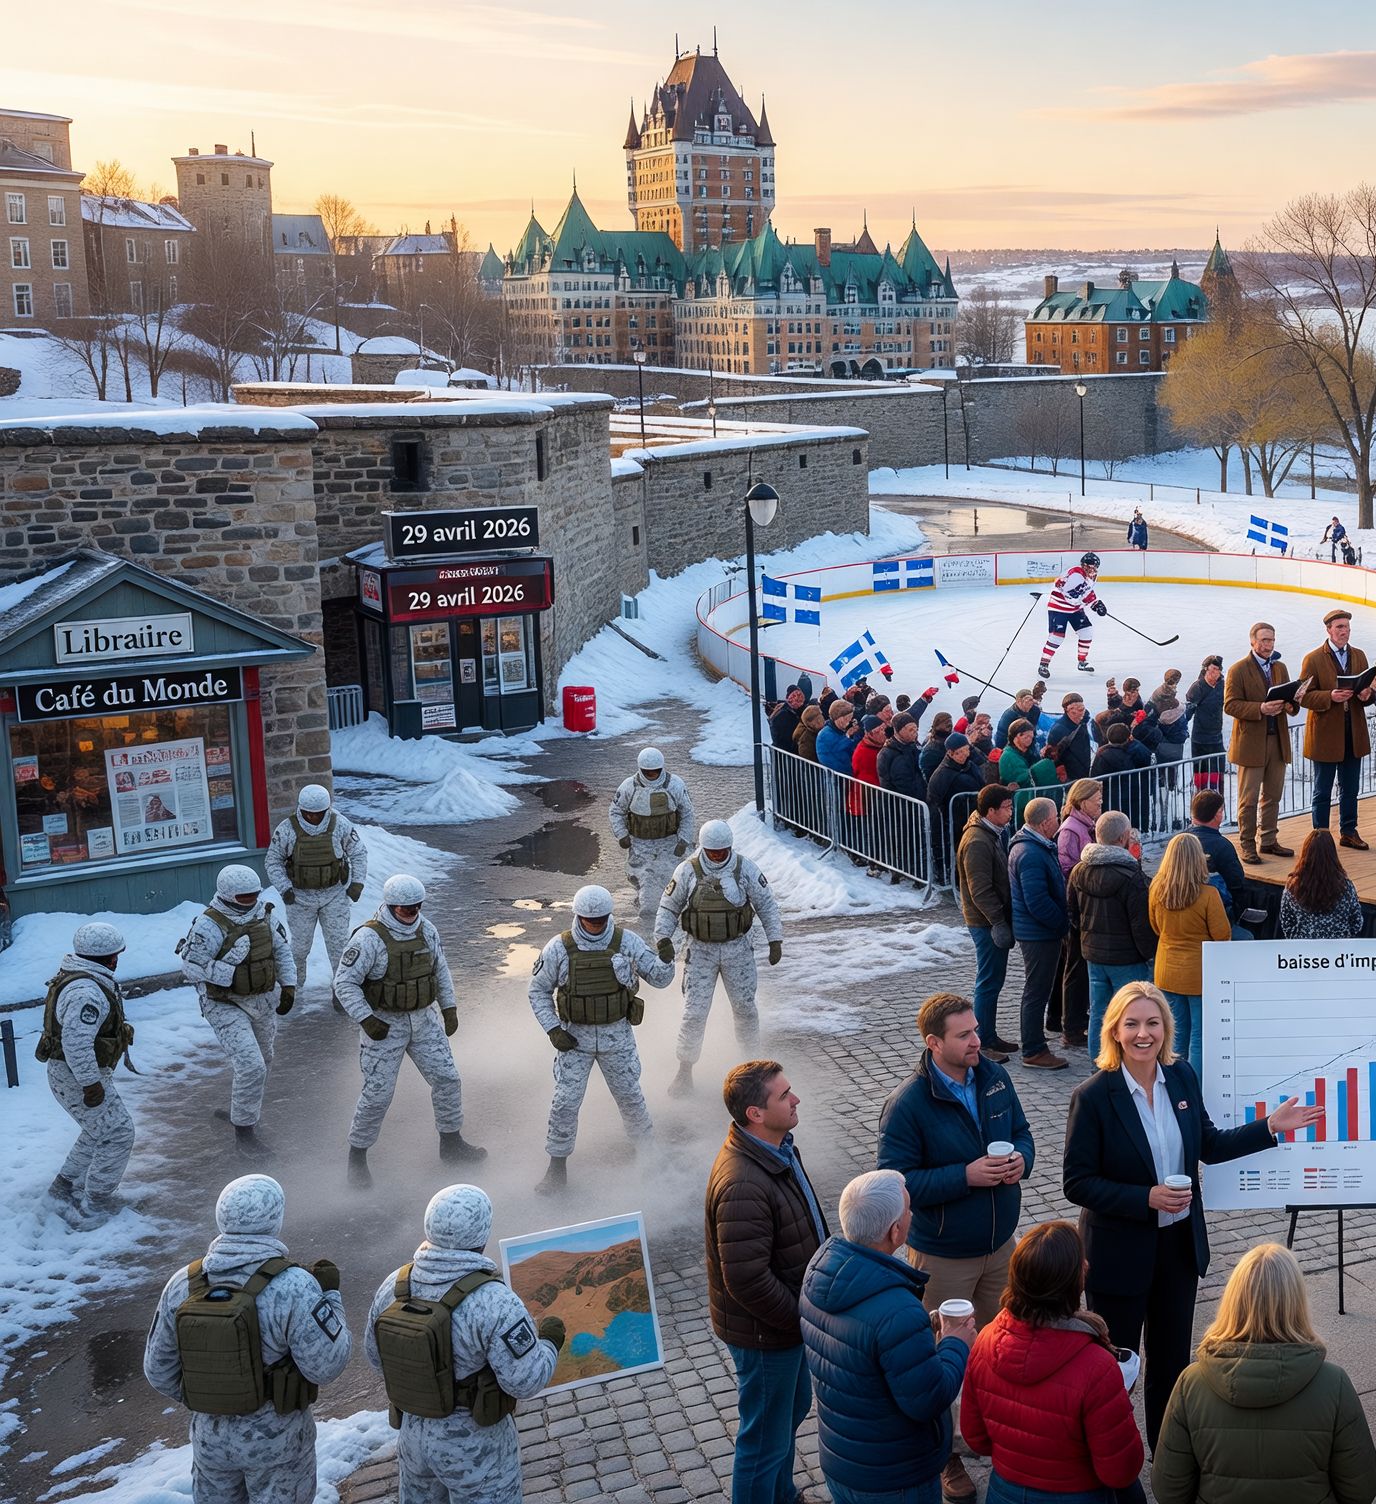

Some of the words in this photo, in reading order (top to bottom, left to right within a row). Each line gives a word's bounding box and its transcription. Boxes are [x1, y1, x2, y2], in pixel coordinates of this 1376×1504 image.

[402, 525, 427, 545] 29
[433, 520, 476, 542] avril
[482, 517, 531, 540] 2026
[408, 592, 431, 610] 29
[437, 586, 476, 607] avril
[481, 584, 525, 605] 2026
[35, 684, 96, 713] Café
[103, 682, 135, 706] du
[142, 673, 228, 703] Monde
[1277, 954, 1330, 969] baisse
